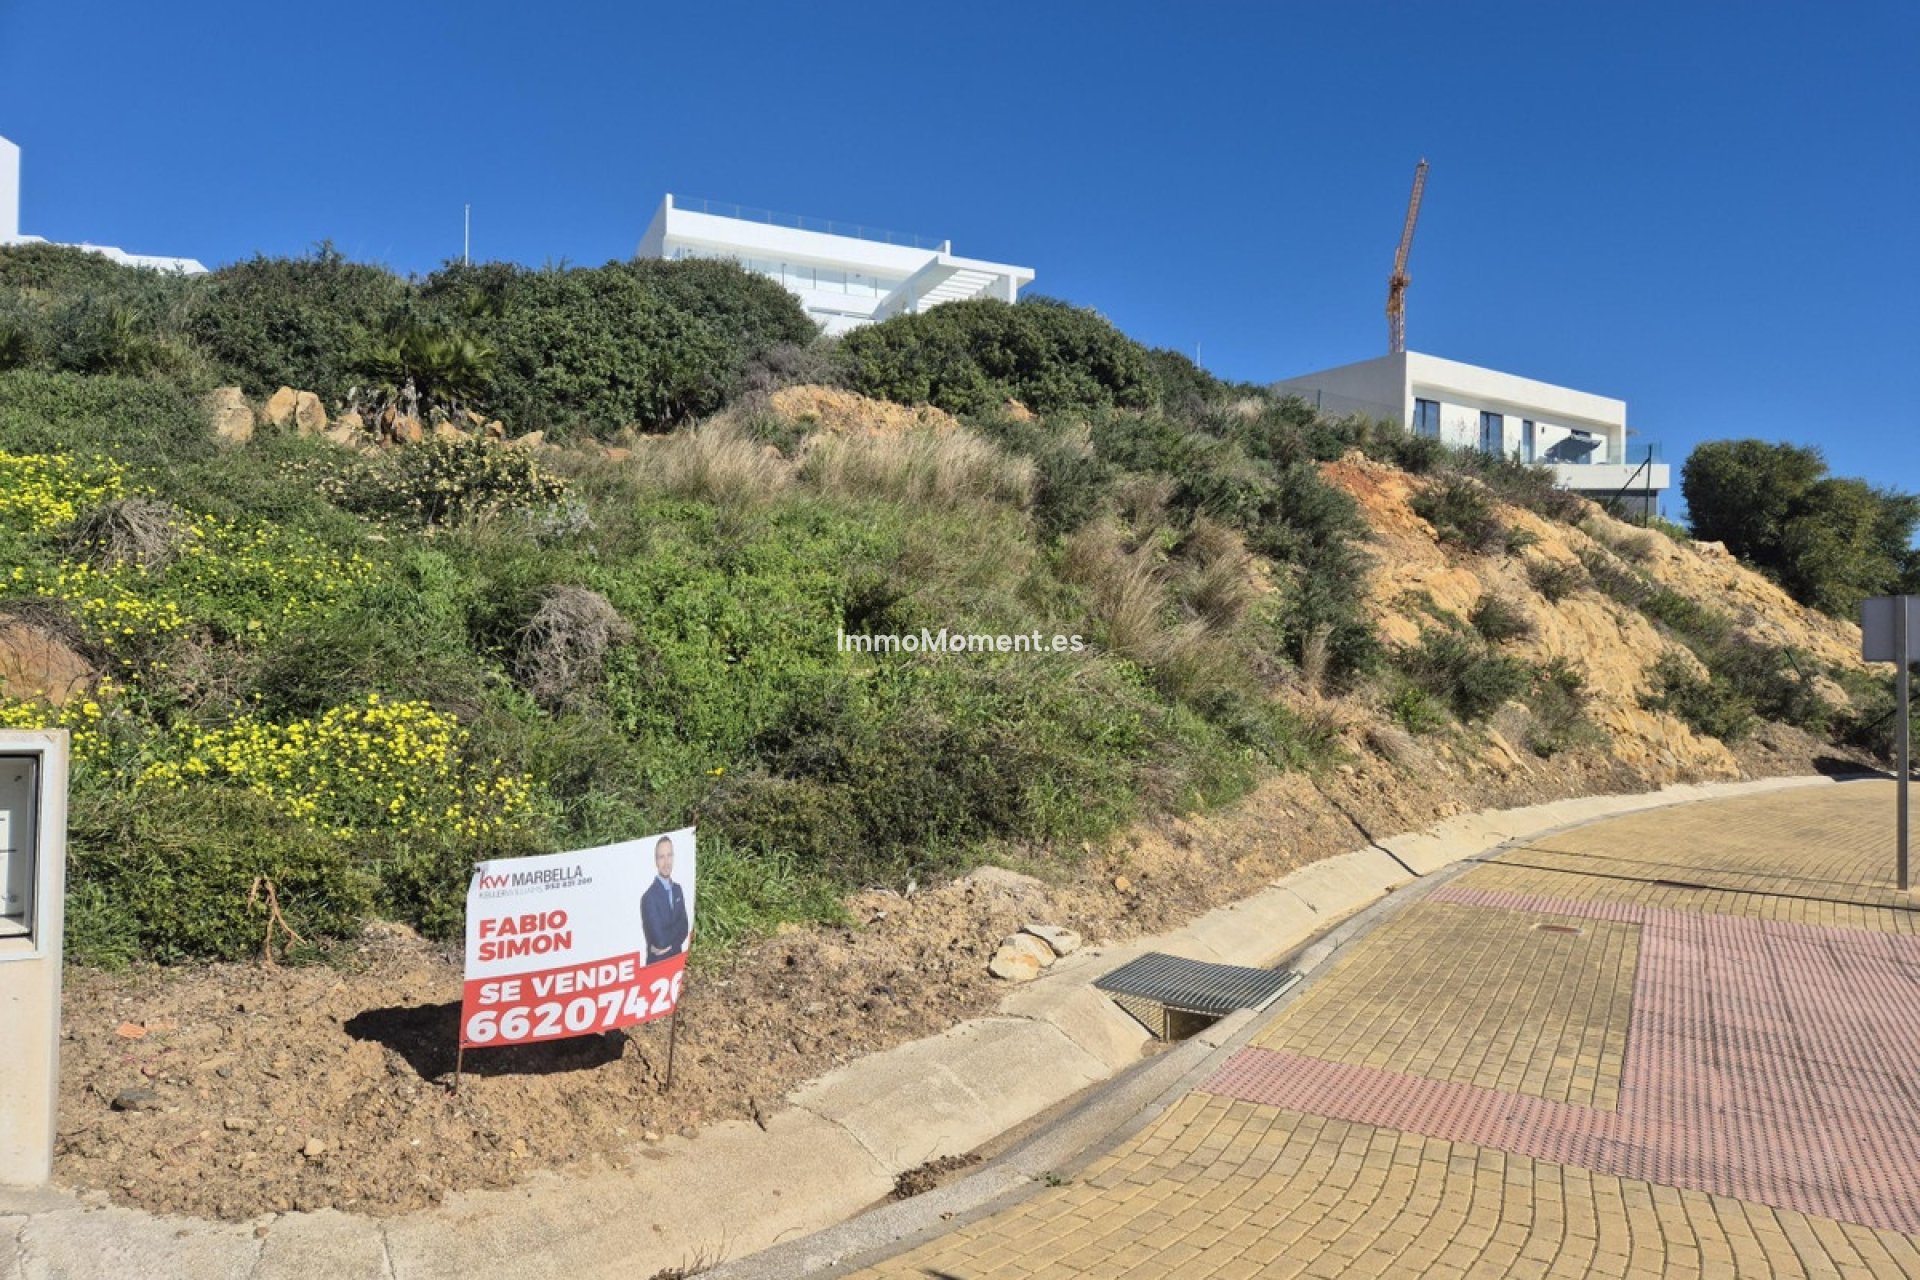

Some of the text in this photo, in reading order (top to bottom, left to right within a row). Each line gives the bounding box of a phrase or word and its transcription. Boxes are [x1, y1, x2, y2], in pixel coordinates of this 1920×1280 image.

[511, 865, 583, 887] MARBELLA
[478, 909, 568, 939] FABIO
[478, 930, 572, 961] SIMON
[478, 958, 635, 1005] SE VENDE
